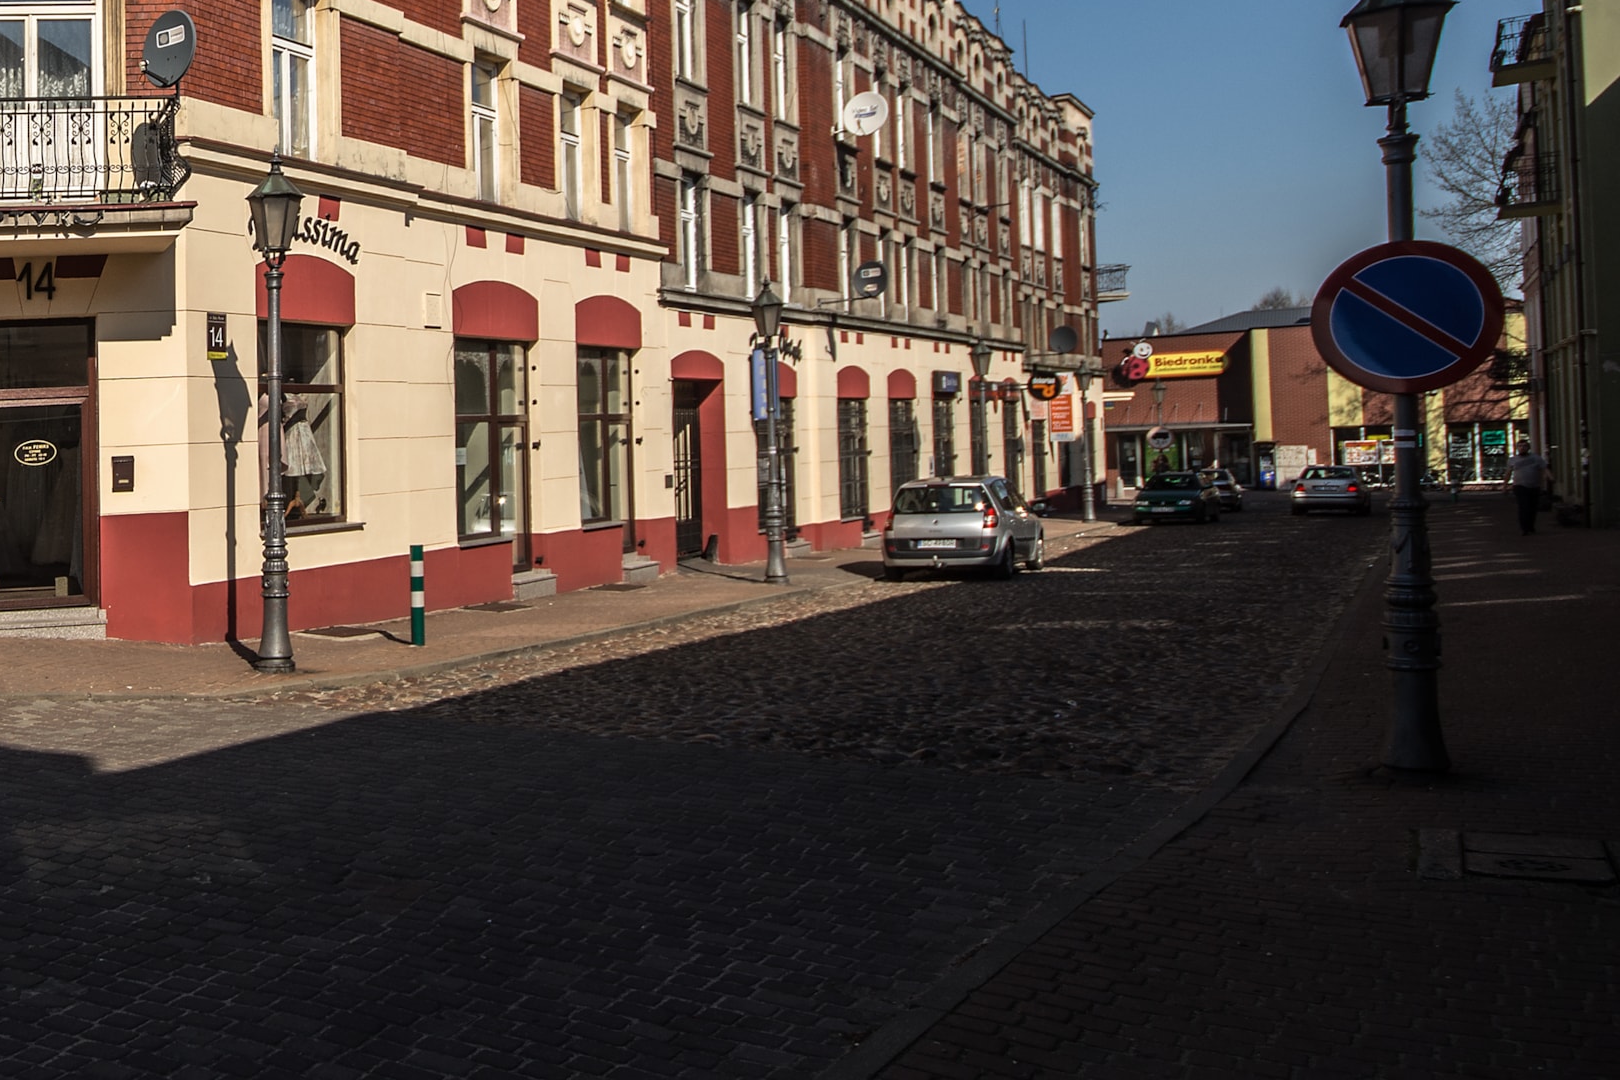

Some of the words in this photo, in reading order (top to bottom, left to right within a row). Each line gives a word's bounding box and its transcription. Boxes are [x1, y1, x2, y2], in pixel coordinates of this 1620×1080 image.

[16, 261, 56, 300] 14
[209, 326, 224, 348] 14
[1155, 355, 1224, 367] Biedronka
